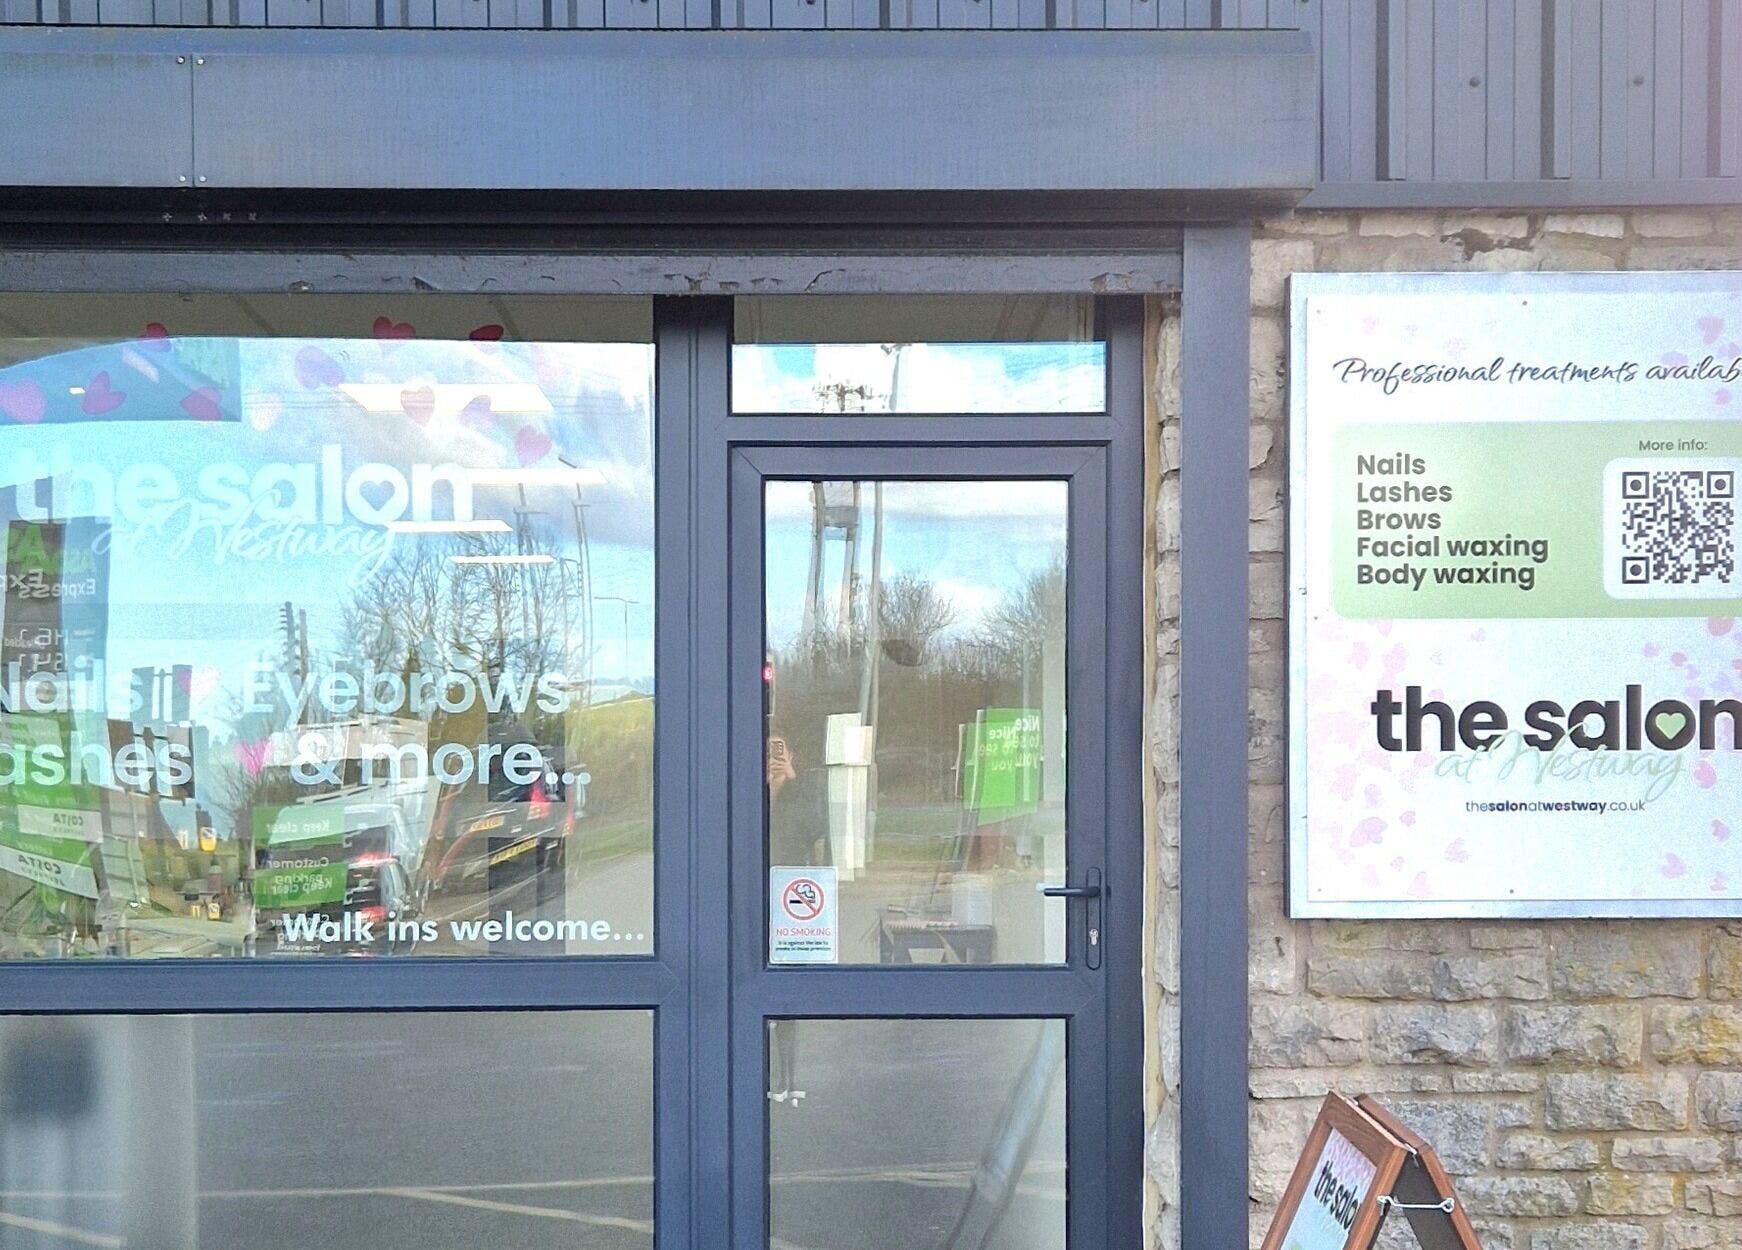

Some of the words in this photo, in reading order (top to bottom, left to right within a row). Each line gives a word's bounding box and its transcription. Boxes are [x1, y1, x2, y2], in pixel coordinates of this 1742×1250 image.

[1333, 356, 1505, 395] Professional
[1508, 360, 1640, 383] treatments
[1639, 439, 1674, 452] More
[1678, 438, 1708, 452] info:
[1357, 453, 1426, 476] Nails
[15, 445, 179, 525] the
[199, 444, 473, 525] salon
[1357, 481, 1453, 504] Lashes
[1357, 509, 1442, 530] Brows
[1357, 536, 1440, 558] Facial
[1447, 534, 1549, 562] waxing
[1357, 564, 1425, 590] Body
[1433, 562, 1536, 590] waxing
[243, 659, 571, 726] Eyebrows
[1371, 686, 1508, 752] the
[1523, 684, 1742, 752] salon
[291, 731, 344, 786] &
[362, 741, 591, 786] more...
[1483, 722, 1685, 803] Westway
[1465, 799, 1646, 814] thesalonatwestway.co.uk
[281, 911, 375, 942] Walk
[387, 912, 439, 942] ins
[450, 910, 645, 942] welcome...
[776, 928, 789, 936] NO
[791, 928, 832, 936] SMOKING
[1314, 1160, 1337, 1207] the
